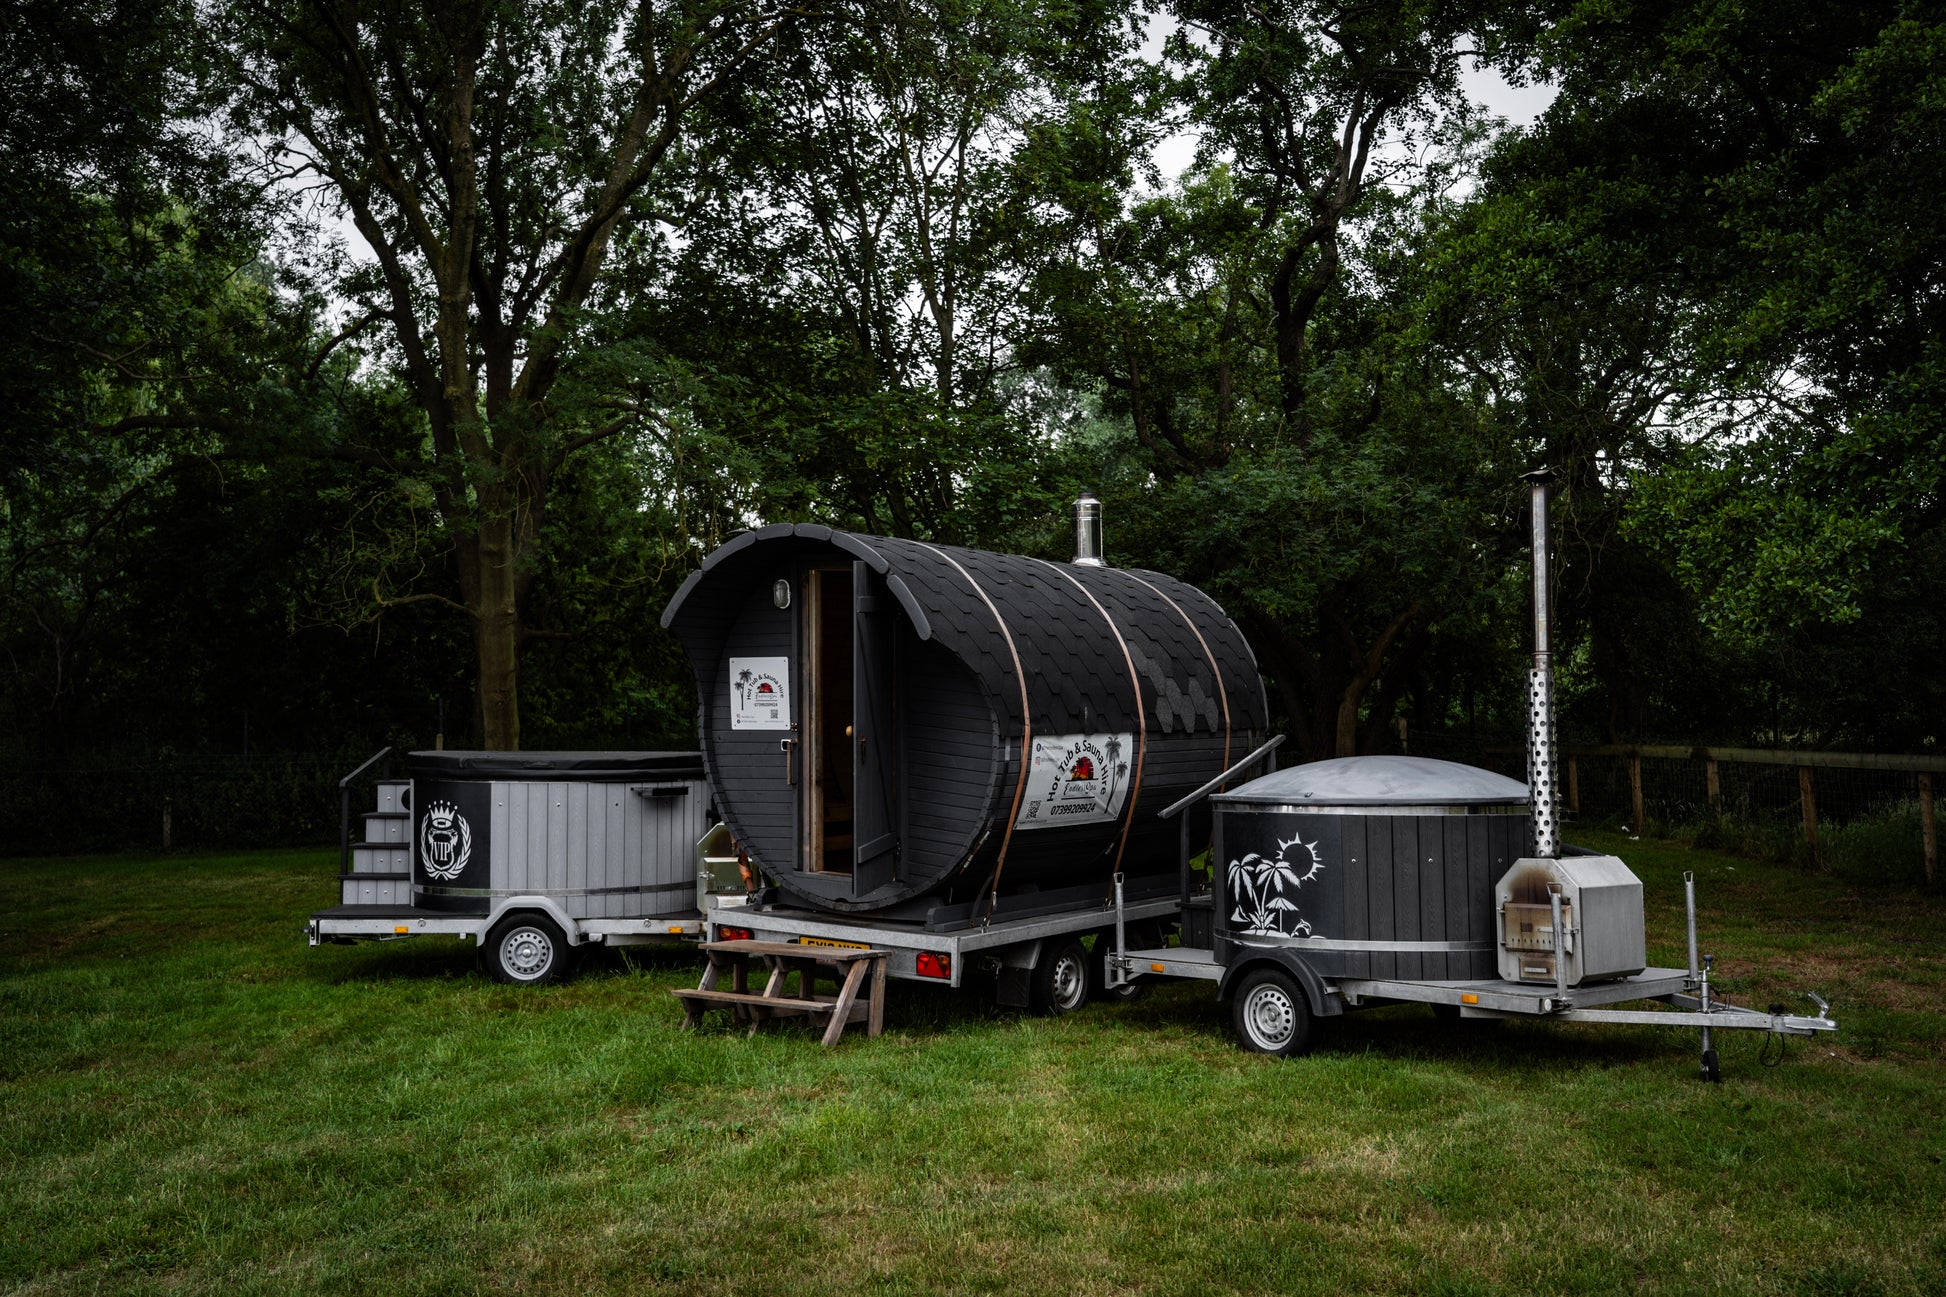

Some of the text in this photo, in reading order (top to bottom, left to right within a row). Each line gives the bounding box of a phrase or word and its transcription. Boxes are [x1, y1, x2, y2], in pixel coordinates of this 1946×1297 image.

[749, 678, 758, 687] Tub
[763, 673, 778, 685] Sauna
[1047, 739, 1109, 802] Hot Tub & Sauna Hire
[1051, 803, 1096, 815] 07399209924
[434, 842, 450, 861] VIP
